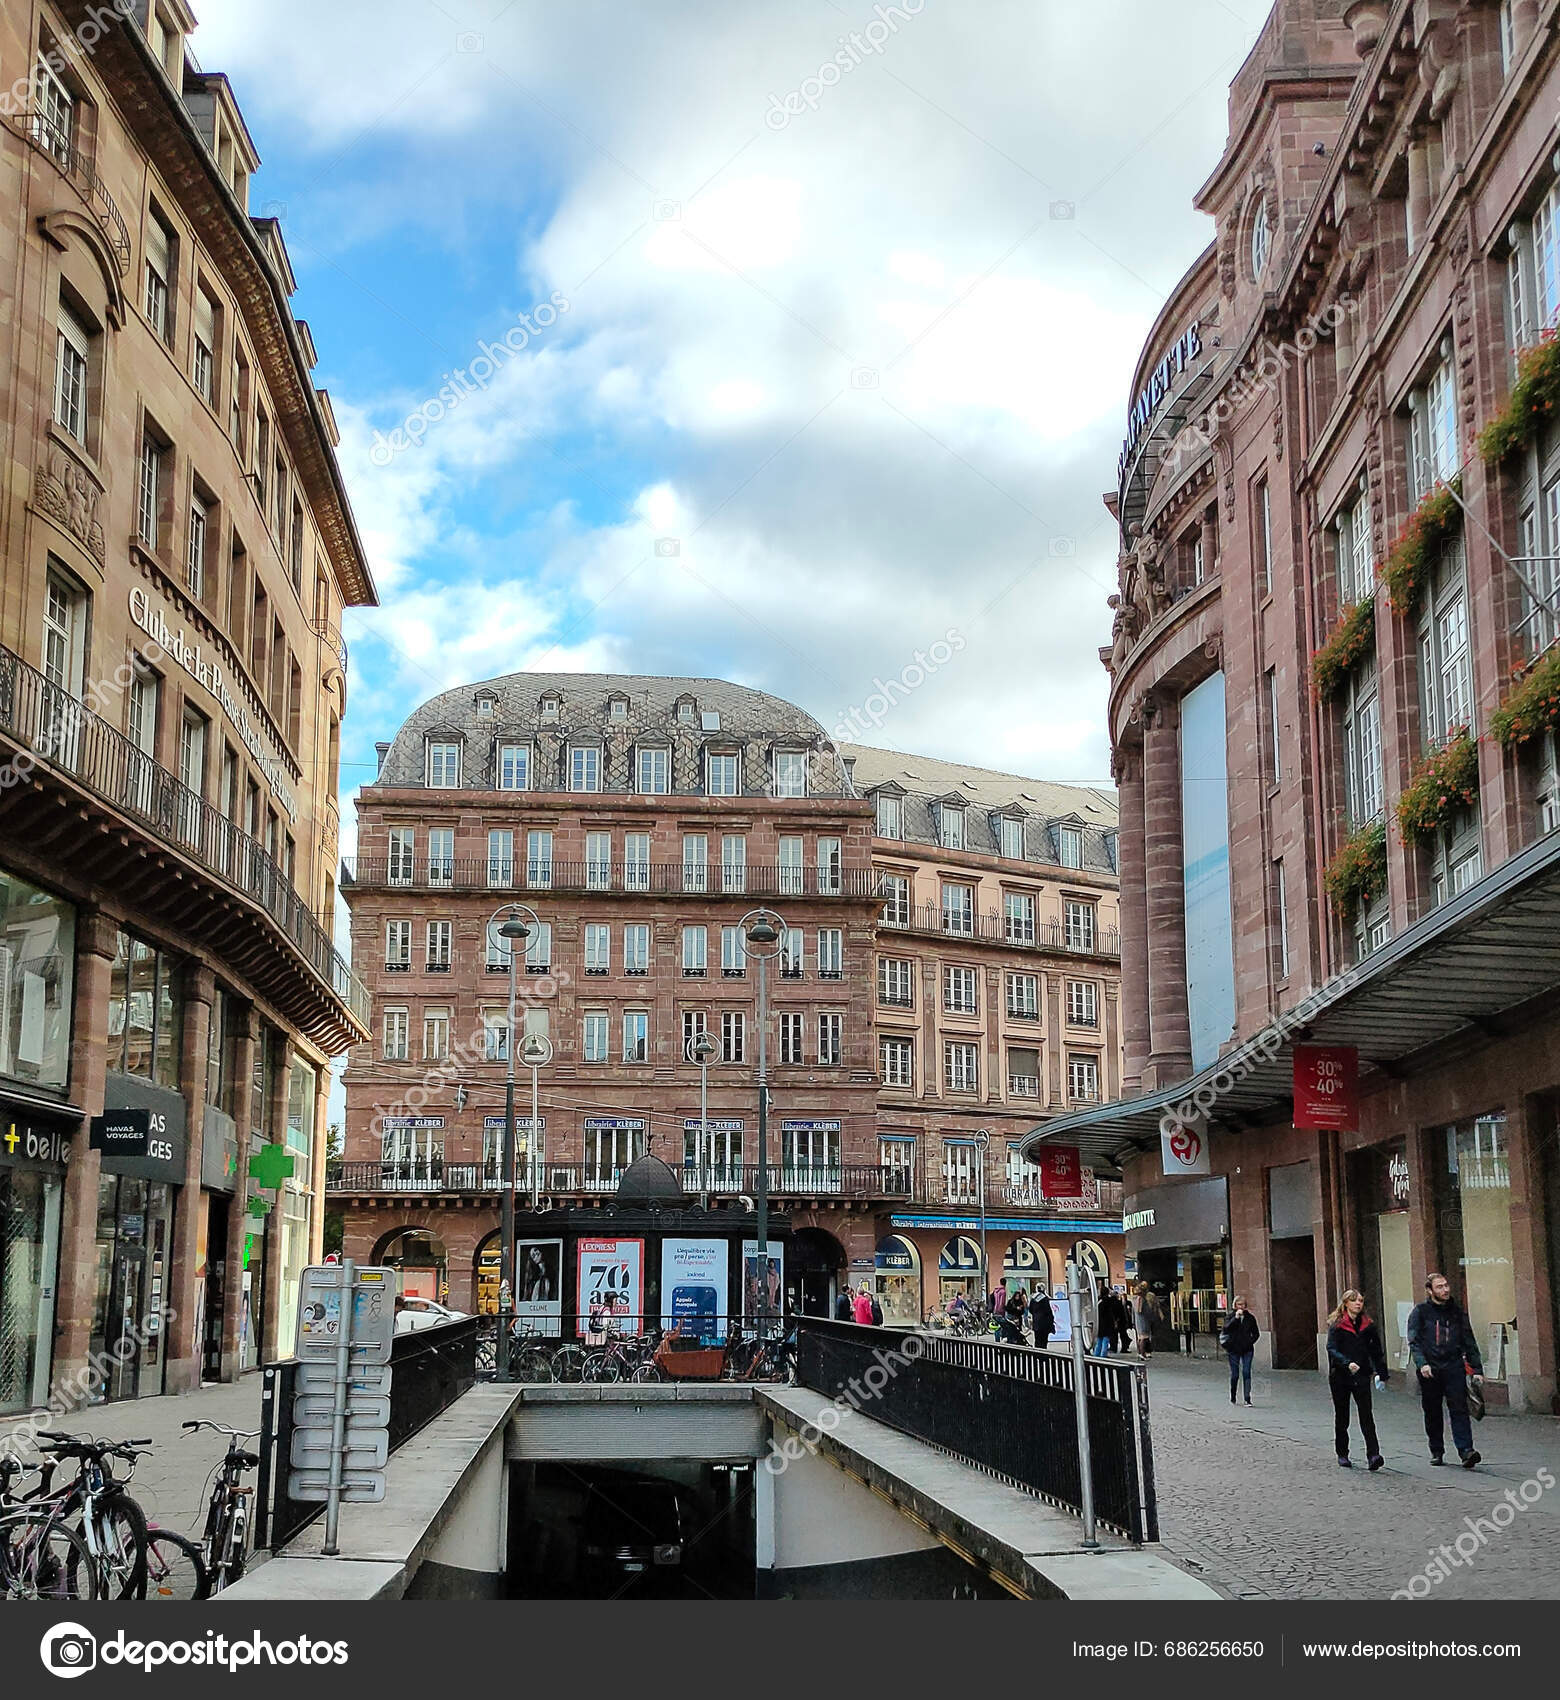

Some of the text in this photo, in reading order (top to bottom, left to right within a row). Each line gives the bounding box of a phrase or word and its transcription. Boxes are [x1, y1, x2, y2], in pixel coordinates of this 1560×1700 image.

[128, 586, 170, 648] Club
[172, 629, 192, 666] de
[194, 645, 209, 684] la
[589, 1264, 630, 1288] 70
